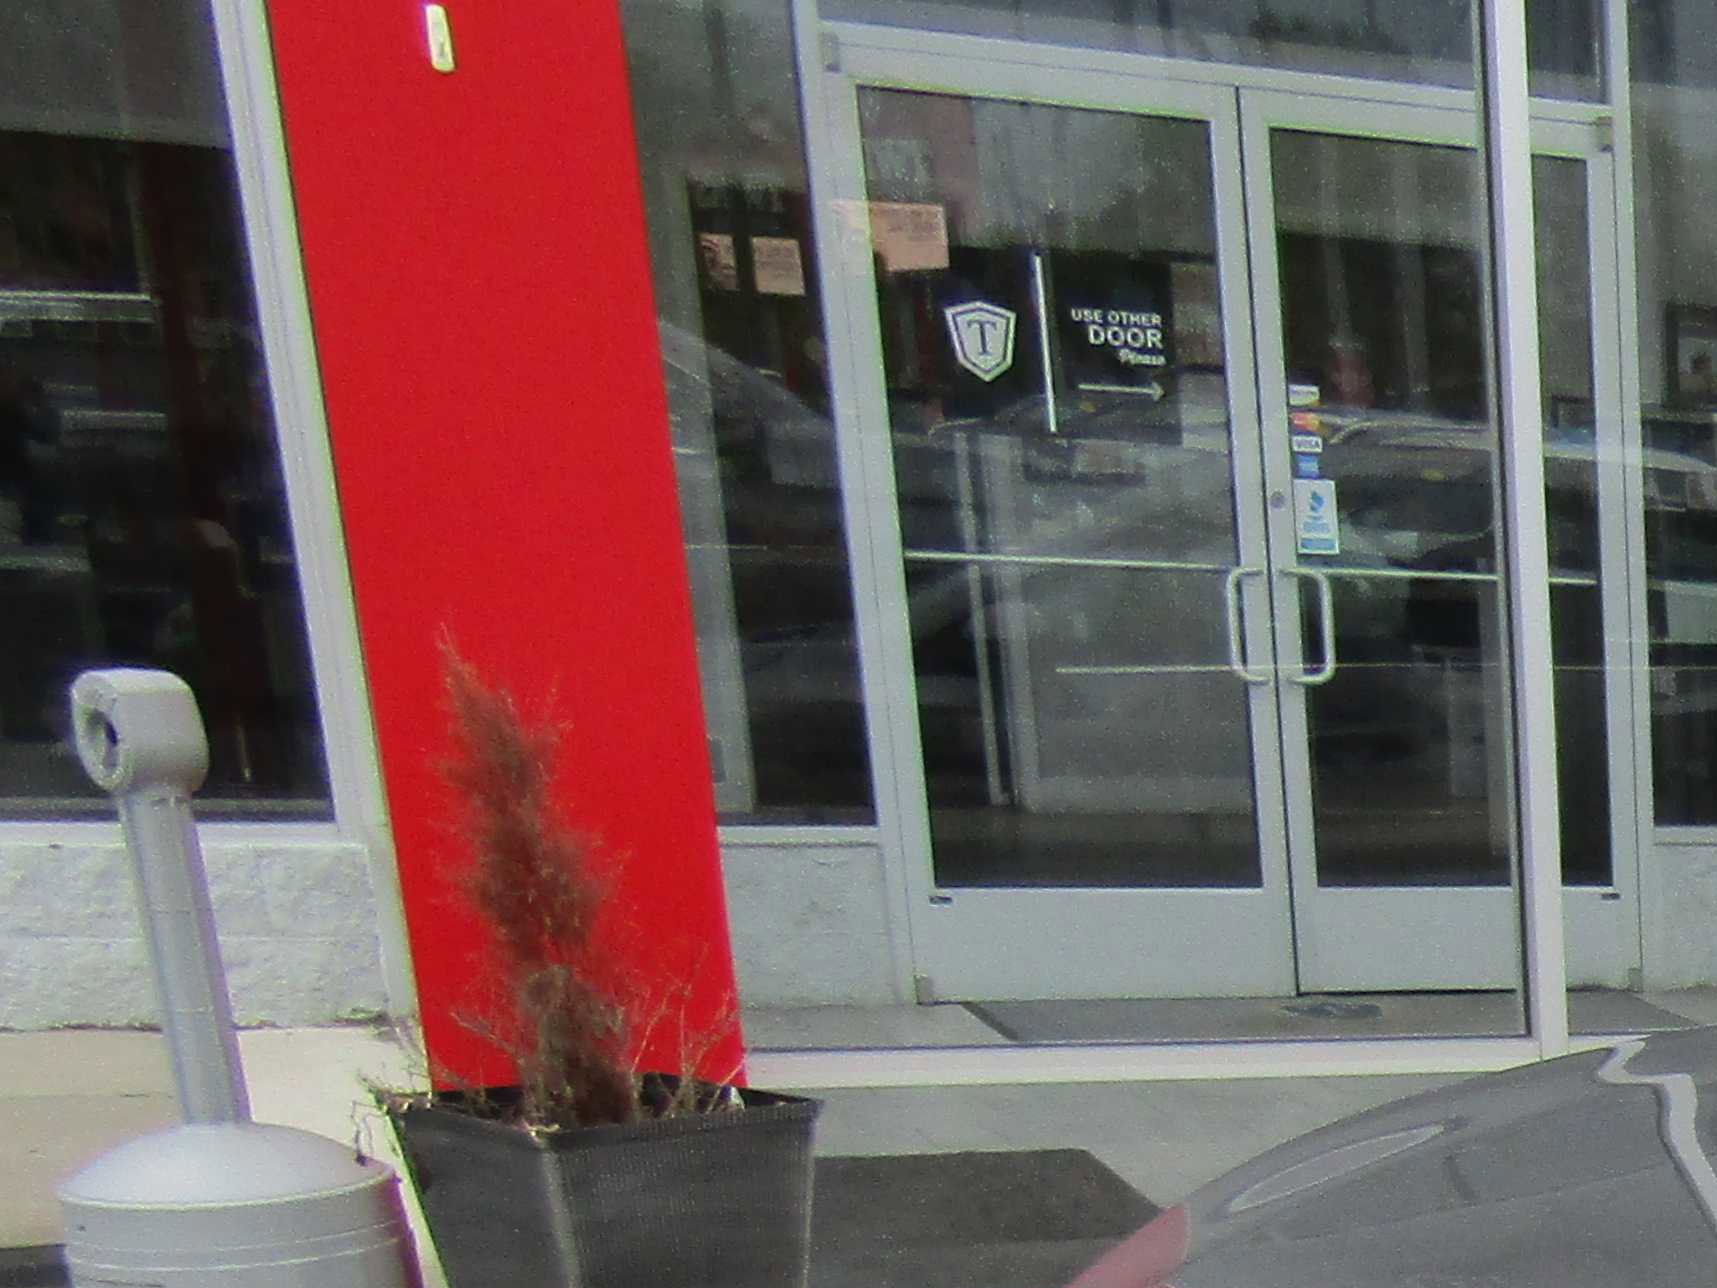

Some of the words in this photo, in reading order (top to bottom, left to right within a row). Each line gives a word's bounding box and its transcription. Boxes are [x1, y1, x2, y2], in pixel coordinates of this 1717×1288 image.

[1071, 307, 1104, 323] USE
[1107, 309, 1162, 328] OTHER
[966, 318, 998, 356] T
[1087, 323, 1163, 350] DOOR
